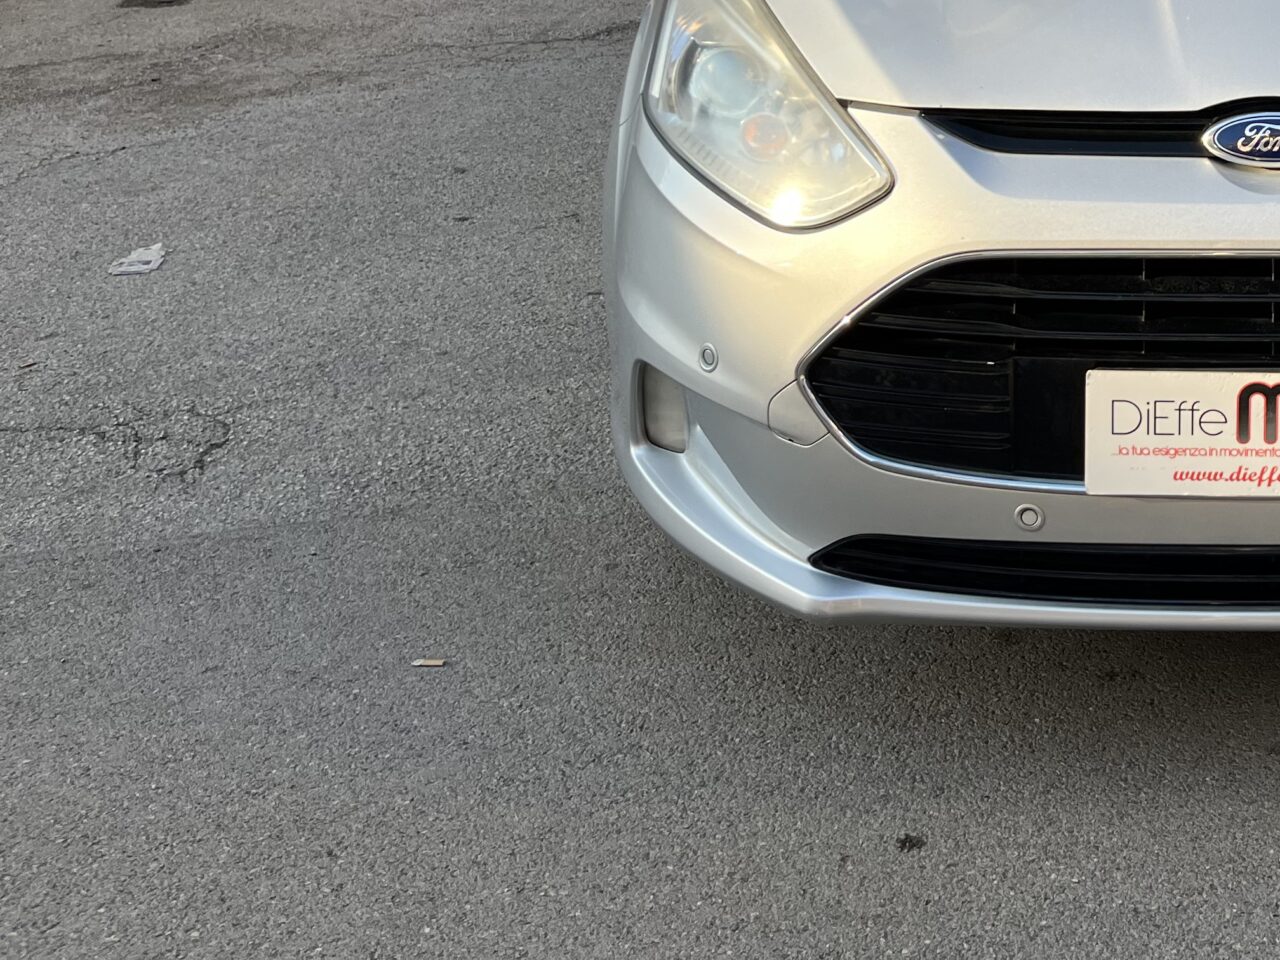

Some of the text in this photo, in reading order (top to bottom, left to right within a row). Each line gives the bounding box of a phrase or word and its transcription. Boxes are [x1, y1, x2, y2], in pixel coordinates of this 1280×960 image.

[1110, 398, 1228, 437] DiEffe
[1131, 446, 1151, 456] tua
[1152, 446, 1207, 459] esigenza
[1208, 447, 1218, 457] in
